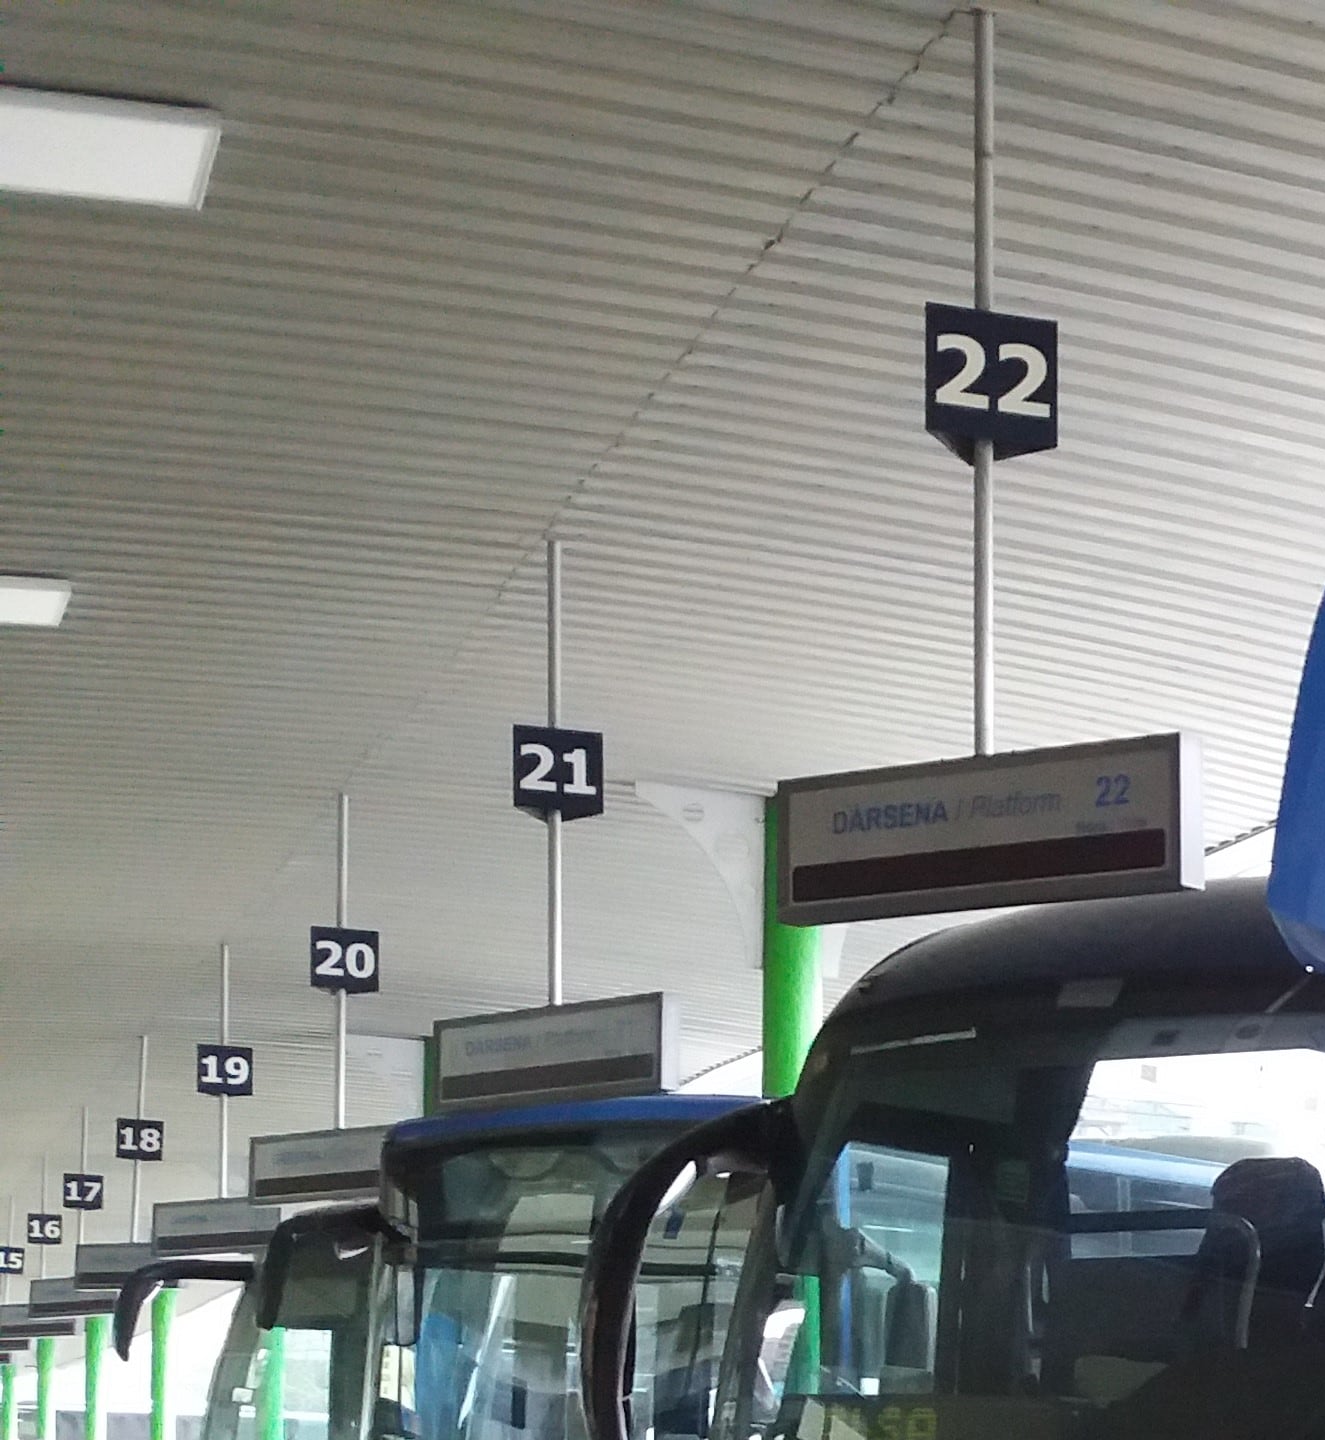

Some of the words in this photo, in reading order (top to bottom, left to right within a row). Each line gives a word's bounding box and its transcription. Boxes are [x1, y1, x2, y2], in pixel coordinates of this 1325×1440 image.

[935, 333, 1051, 418] 22
[518, 743, 597, 795] 21
[1095, 774, 1131, 808] 22
[314, 940, 375, 978] 20
[199, 1054, 250, 1084] 19
[119, 1127, 161, 1152] 18
[65, 1181, 101, 1202] 17
[28, 1220, 60, 1238] 16
